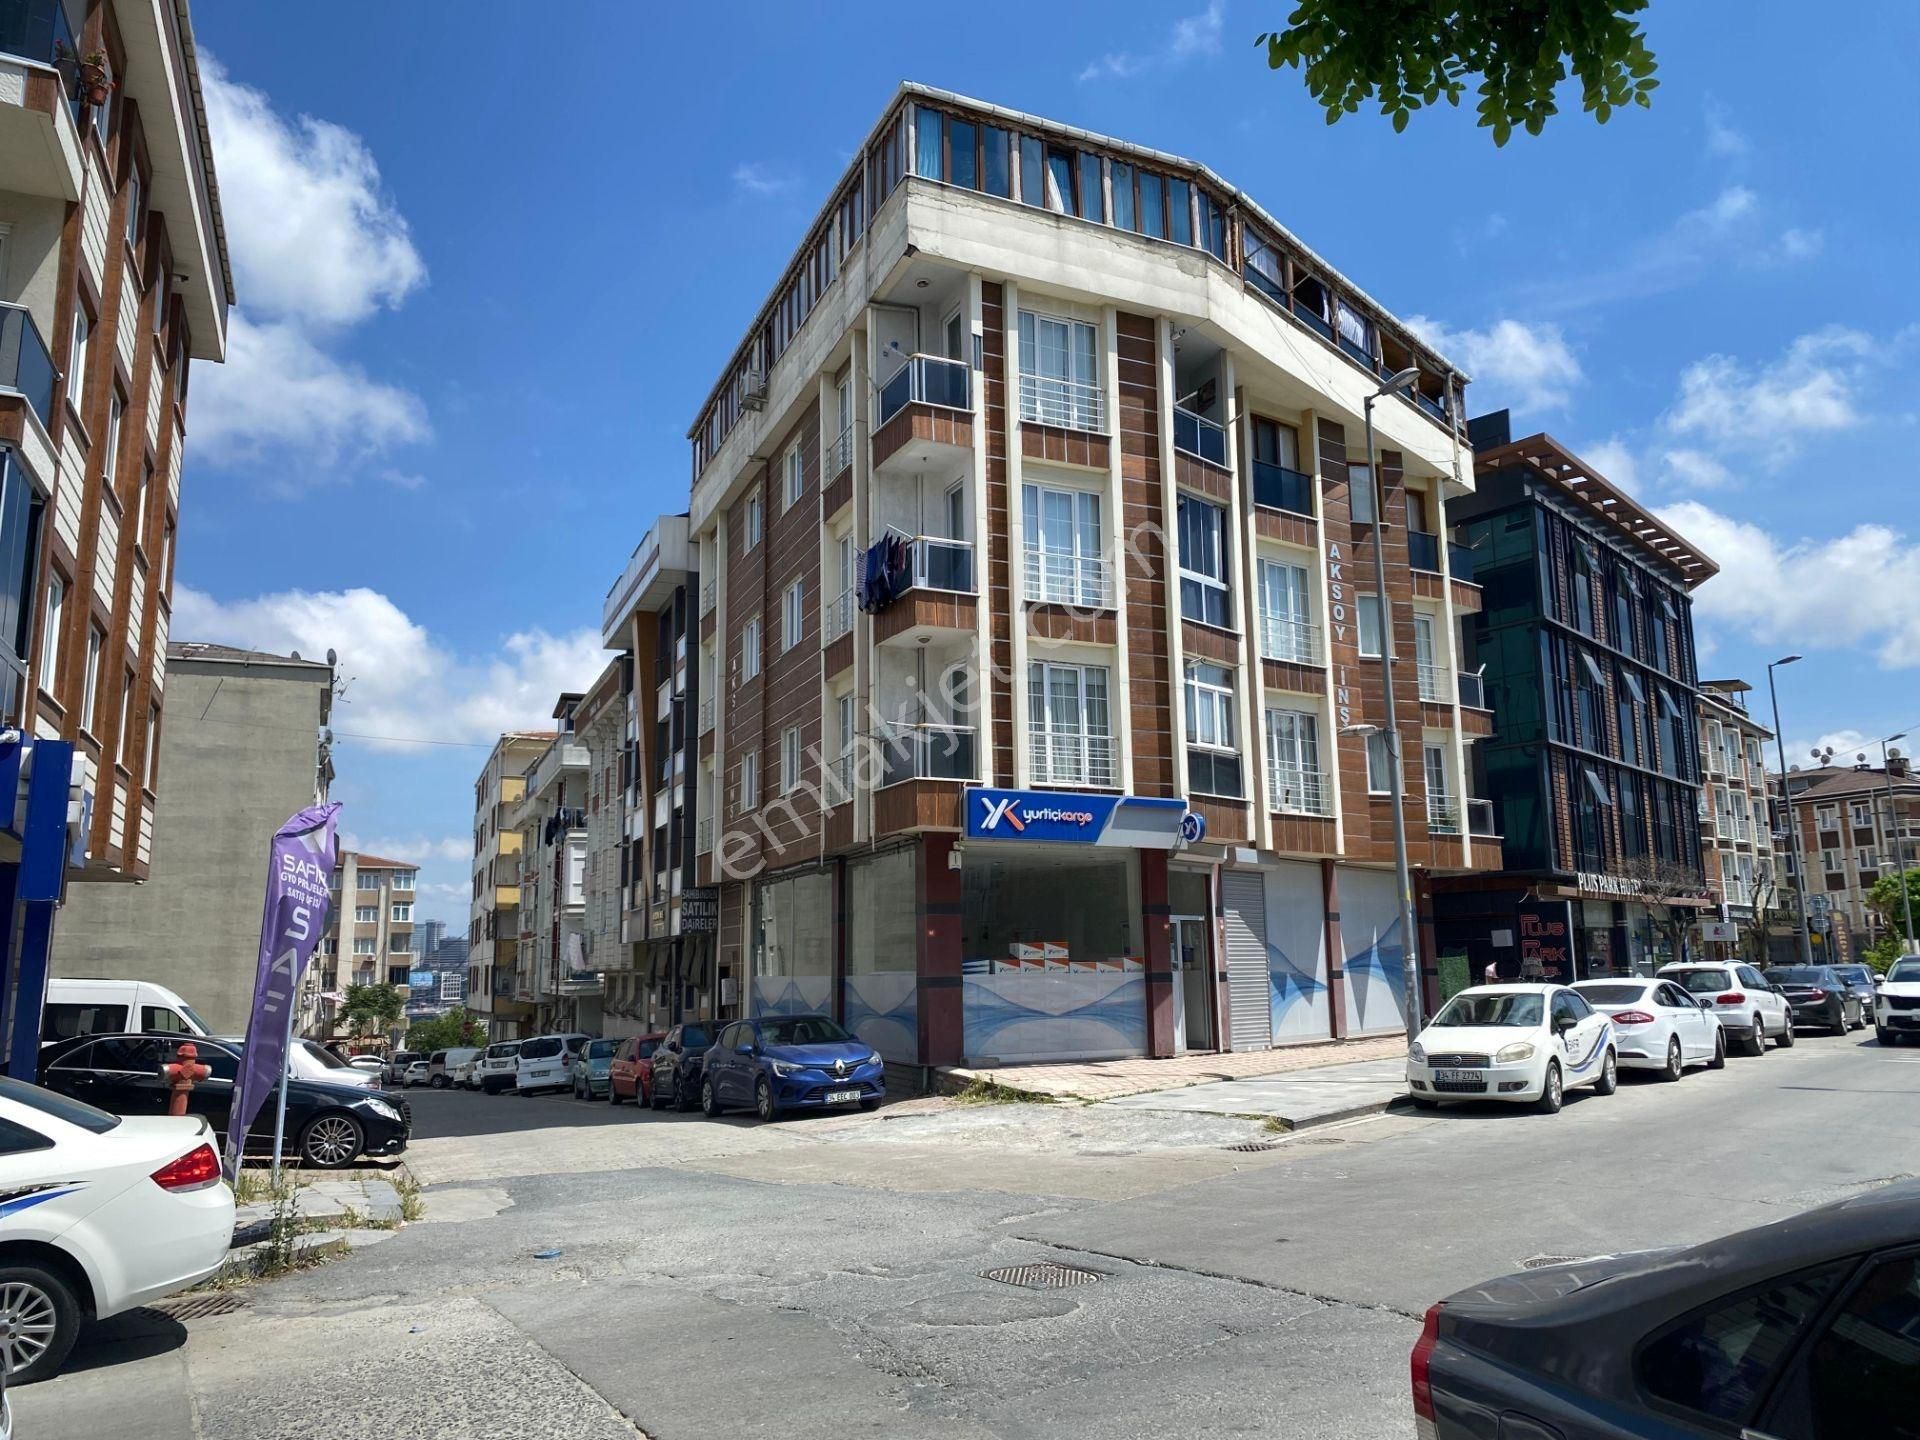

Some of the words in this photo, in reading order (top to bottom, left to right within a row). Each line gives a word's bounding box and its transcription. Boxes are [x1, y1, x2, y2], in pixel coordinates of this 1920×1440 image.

[1329, 543, 1347, 641] AKSOY
[1577, 872, 1599, 892] PLUS
[1598, 874, 1620, 895] PARK
[682, 902, 718, 916] SATILIK
